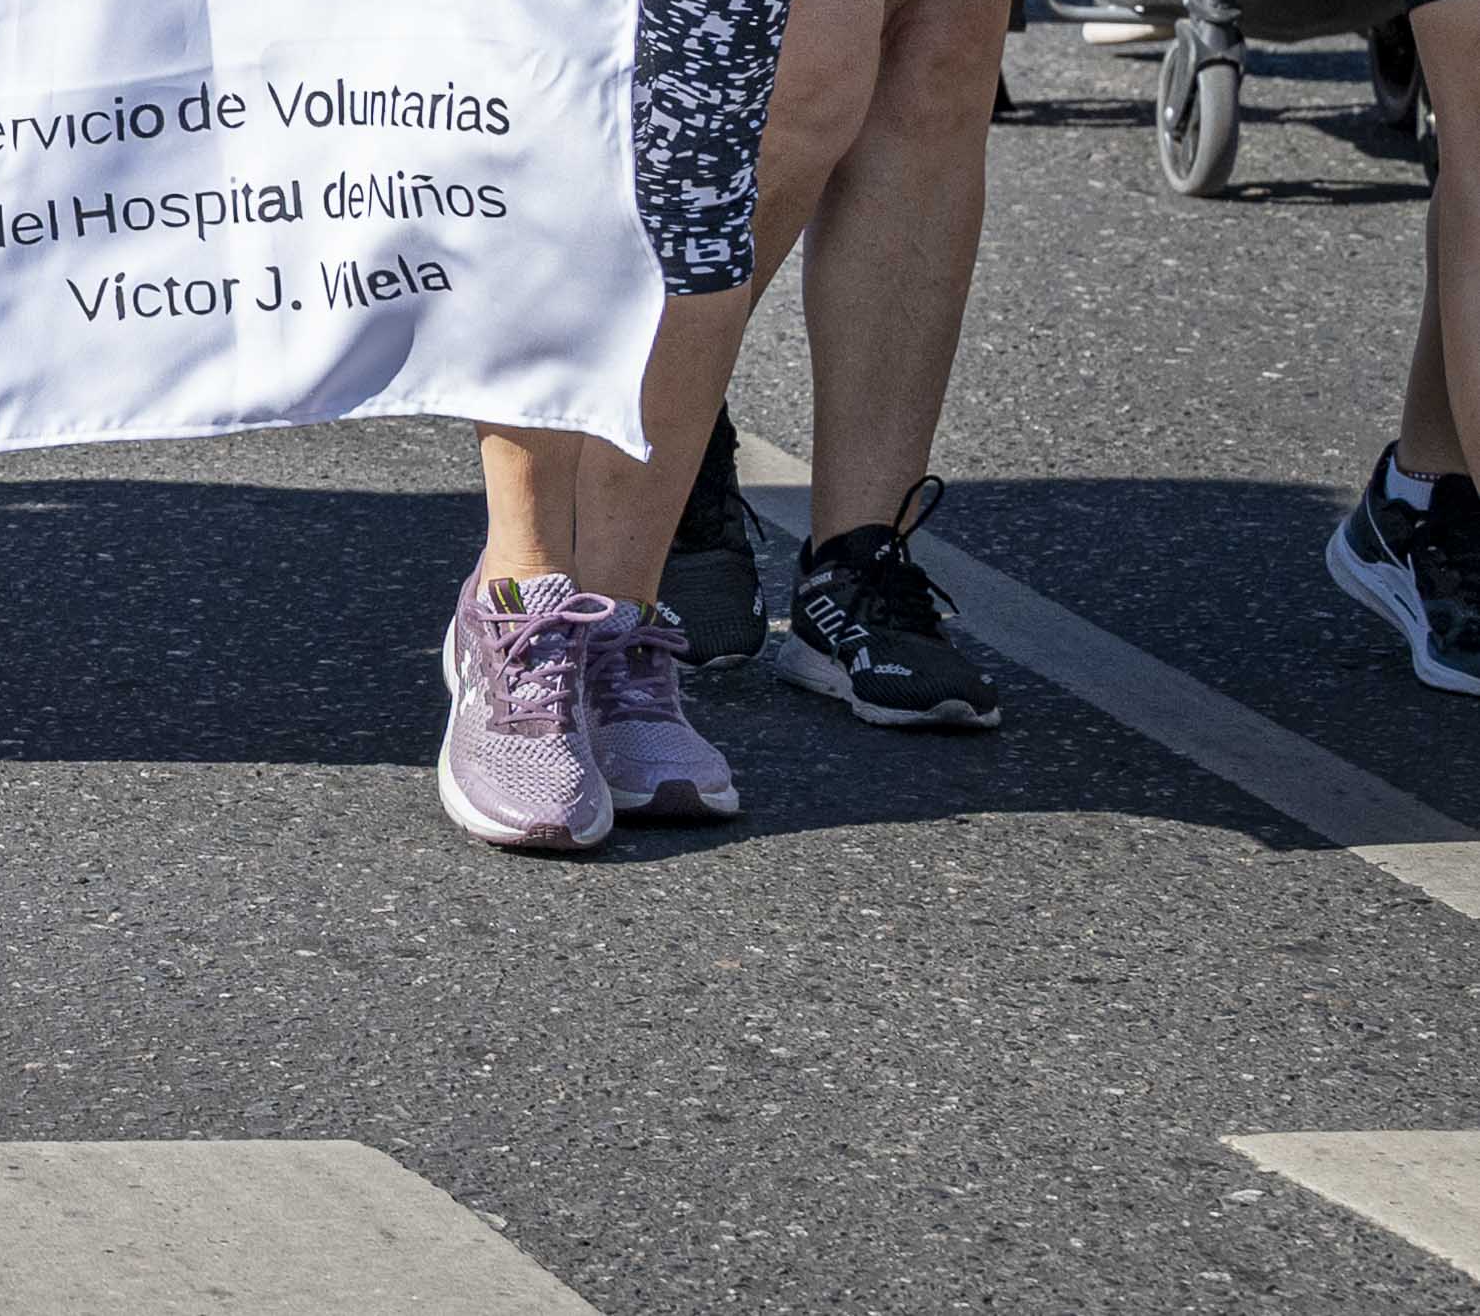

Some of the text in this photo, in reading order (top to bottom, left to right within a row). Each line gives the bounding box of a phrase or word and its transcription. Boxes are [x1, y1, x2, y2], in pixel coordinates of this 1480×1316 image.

[178, 82, 247, 133] de
[266, 78, 511, 137] Voluntarias
[72, 177, 304, 243] Hospital
[368, 172, 508, 220] Niños
[66, 253, 453, 322] Víctor J. Vilela
